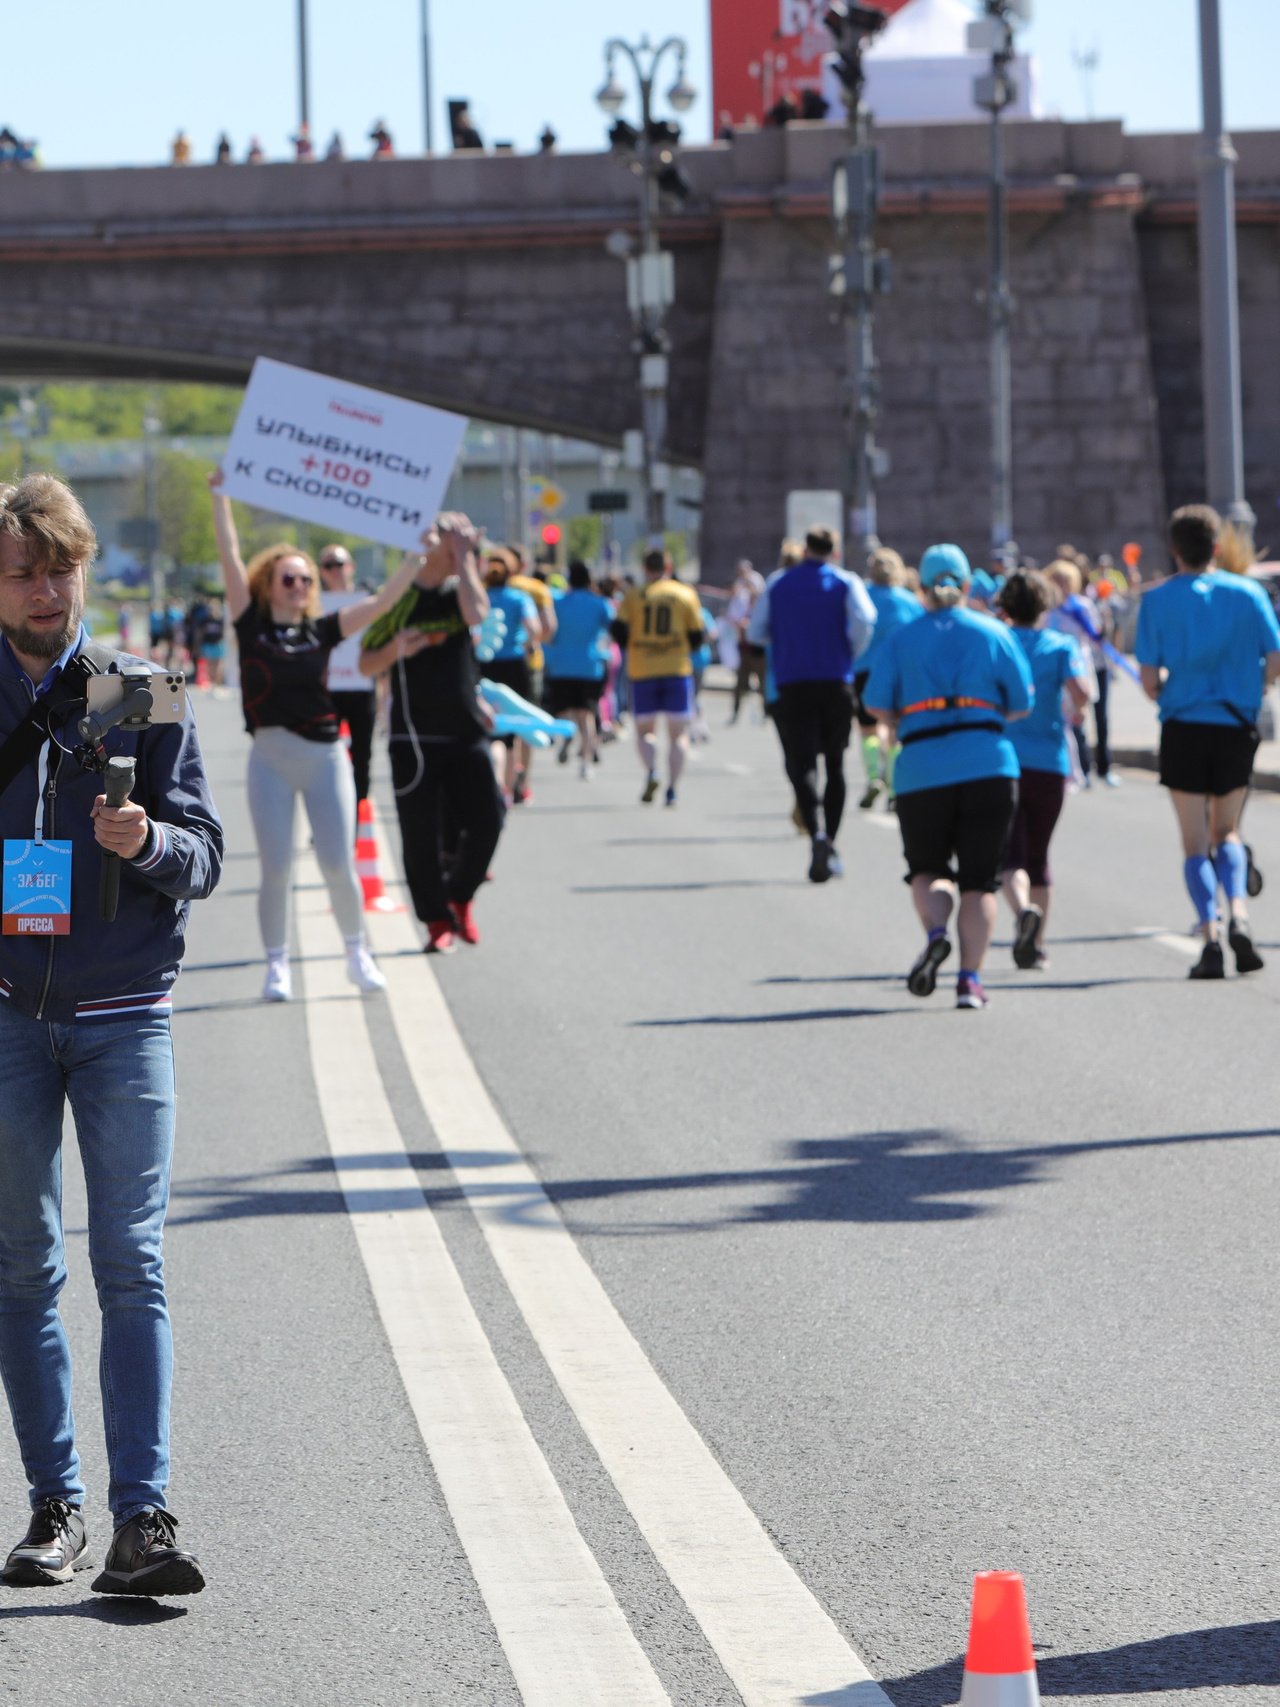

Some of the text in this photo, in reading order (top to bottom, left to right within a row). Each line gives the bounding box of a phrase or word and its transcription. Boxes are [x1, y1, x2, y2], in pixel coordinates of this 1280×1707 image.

[255, 415, 432, 481] УЛЫБНИСЬ!
[300, 454, 372, 488] +100
[234, 457, 422, 526] К СКОРОСТИ
[644, 604, 671, 636] 10
[17, 917, 54, 932] ПРЕССА
